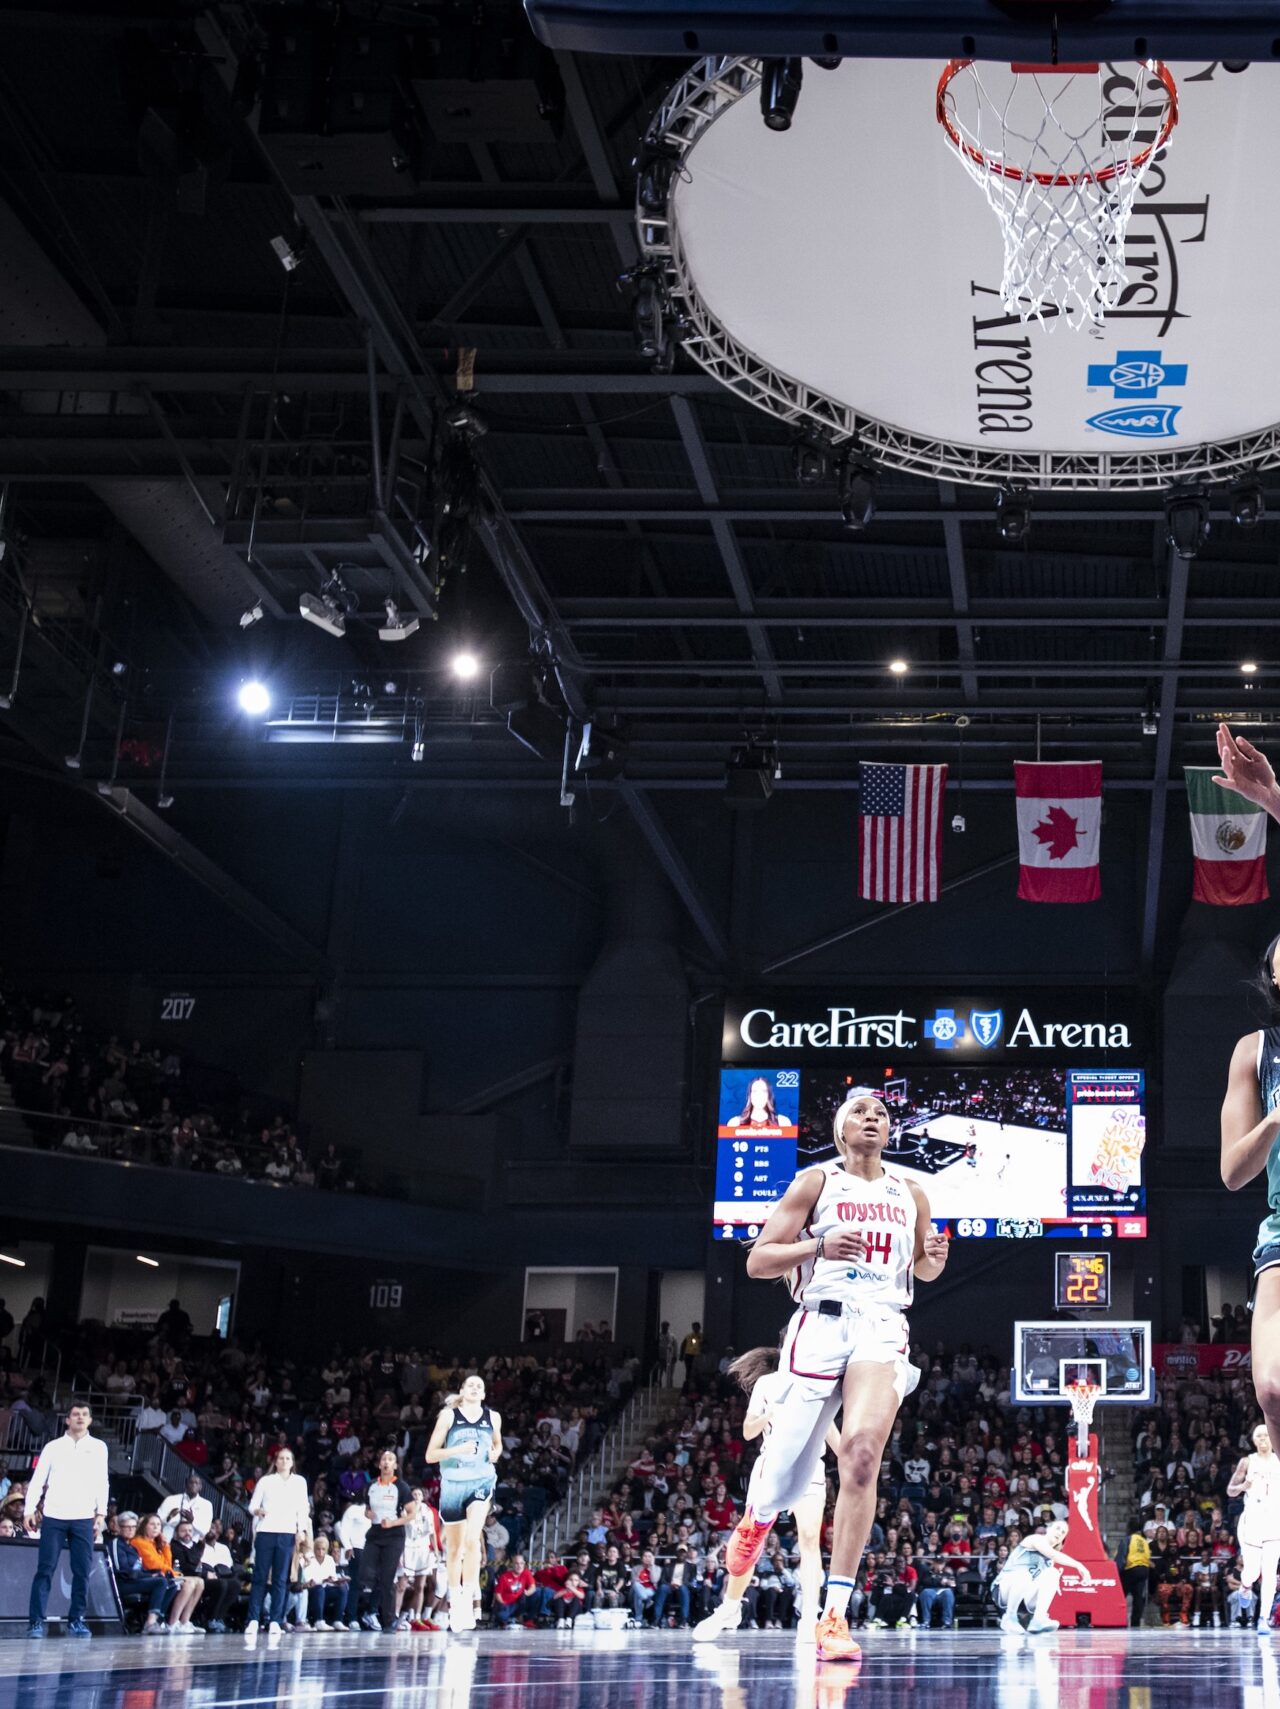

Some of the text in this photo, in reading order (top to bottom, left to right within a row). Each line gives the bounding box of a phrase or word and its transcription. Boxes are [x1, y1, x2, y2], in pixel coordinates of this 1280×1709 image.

[1094, 61, 1215, 337] areFirst
[971, 280, 1074, 435] Arena
[160, 998, 196, 1020] 207
[740, 1008, 1131, 1049] CareFirst Arena
[776, 1072, 799, 1088] 22
[1072, 1085, 1139, 1102] PRIDE
[732, 1141, 749, 1153] 10
[734, 1157, 745, 1168] 3
[733, 1171, 744, 1182] 0
[733, 1185, 744, 1197] 2
[722, 1224, 759, 1238] 2 0
[957, 1218, 987, 1237] 69
[1079, 1223, 1113, 1237] 1 3
[1072, 1258, 1104, 1274] 7:46
[1067, 1274, 1099, 1301] 22
[369, 1285, 403, 1309] 109
